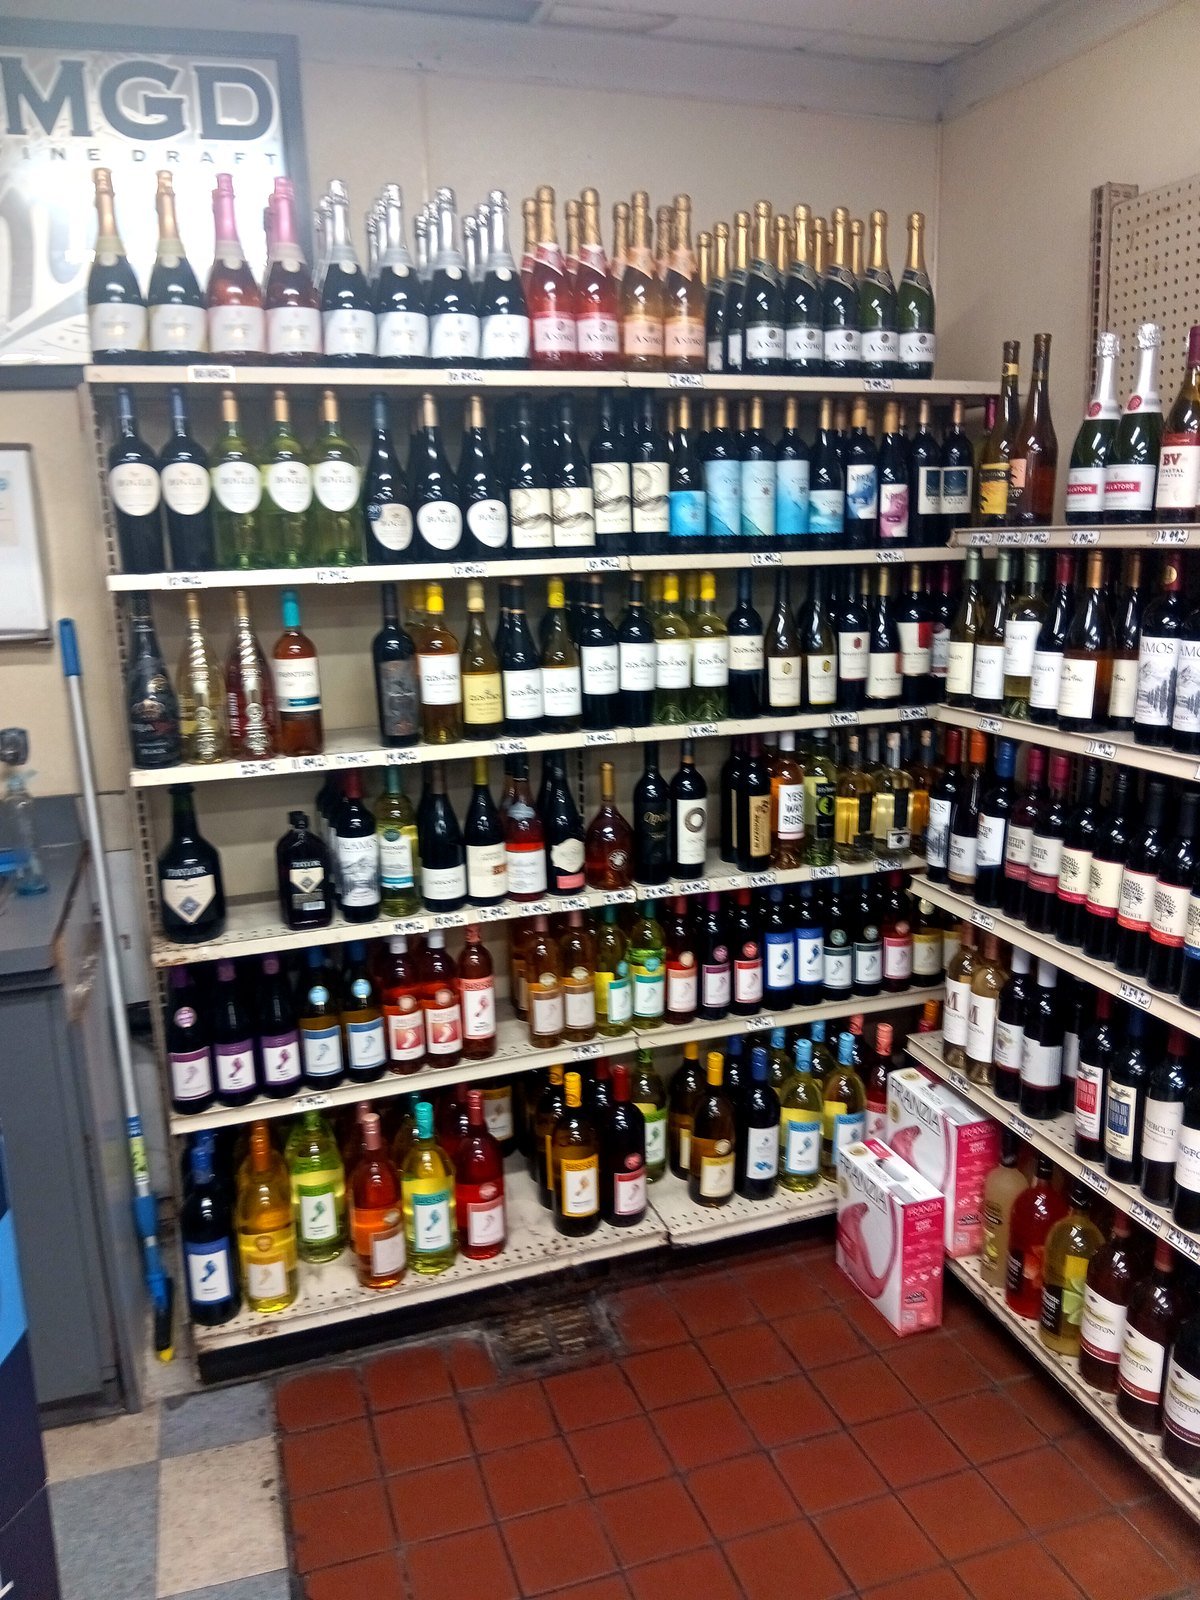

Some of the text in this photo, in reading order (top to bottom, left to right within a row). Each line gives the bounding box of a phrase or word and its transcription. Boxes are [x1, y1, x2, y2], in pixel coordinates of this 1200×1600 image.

[0, 56, 274, 140] MGD
[132, 149, 278, 165] DRAFT
[1162, 453, 1182, 466] BV
[890, 1074, 941, 1135] FRANZIA
[838, 1155, 888, 1213] FRANZIA
[907, 1202, 942, 1217] FRANZIA
